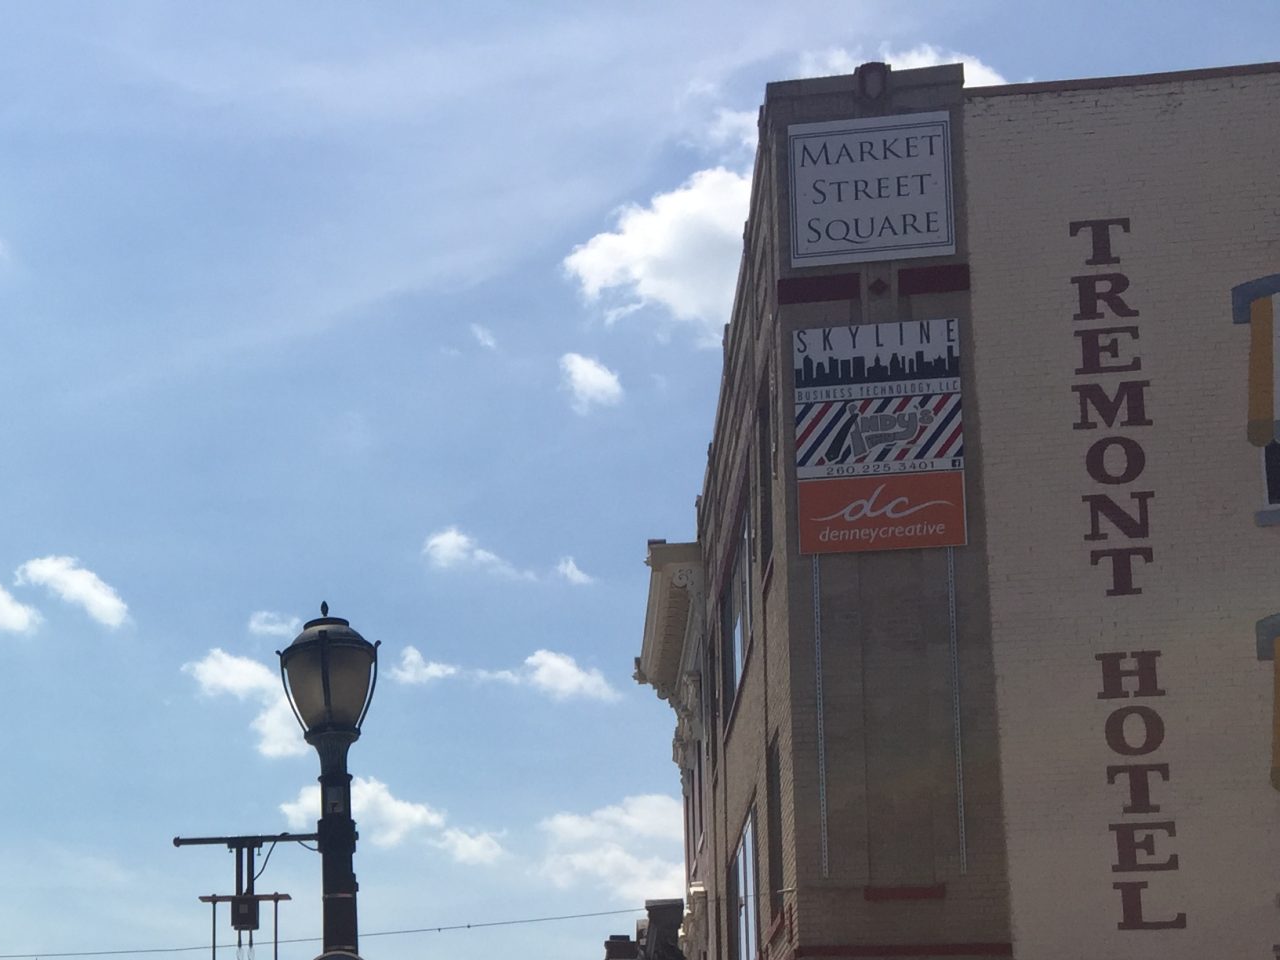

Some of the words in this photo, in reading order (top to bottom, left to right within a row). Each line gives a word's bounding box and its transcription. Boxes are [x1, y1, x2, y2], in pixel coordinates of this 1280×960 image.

[799, 134, 942, 168] MARKET
[812, 173, 933, 206] STREET
[807, 211, 940, 245] SQUARE
[796, 319, 956, 354] SKYLINE
[797, 387, 853, 402] BUSINESS
[1068, 217, 1154, 596] TREMONT
[826, 461, 936, 476] 260.225.3401
[819, 521, 946, 544] denneycreative
[1094, 649, 1188, 932] HOTEL
